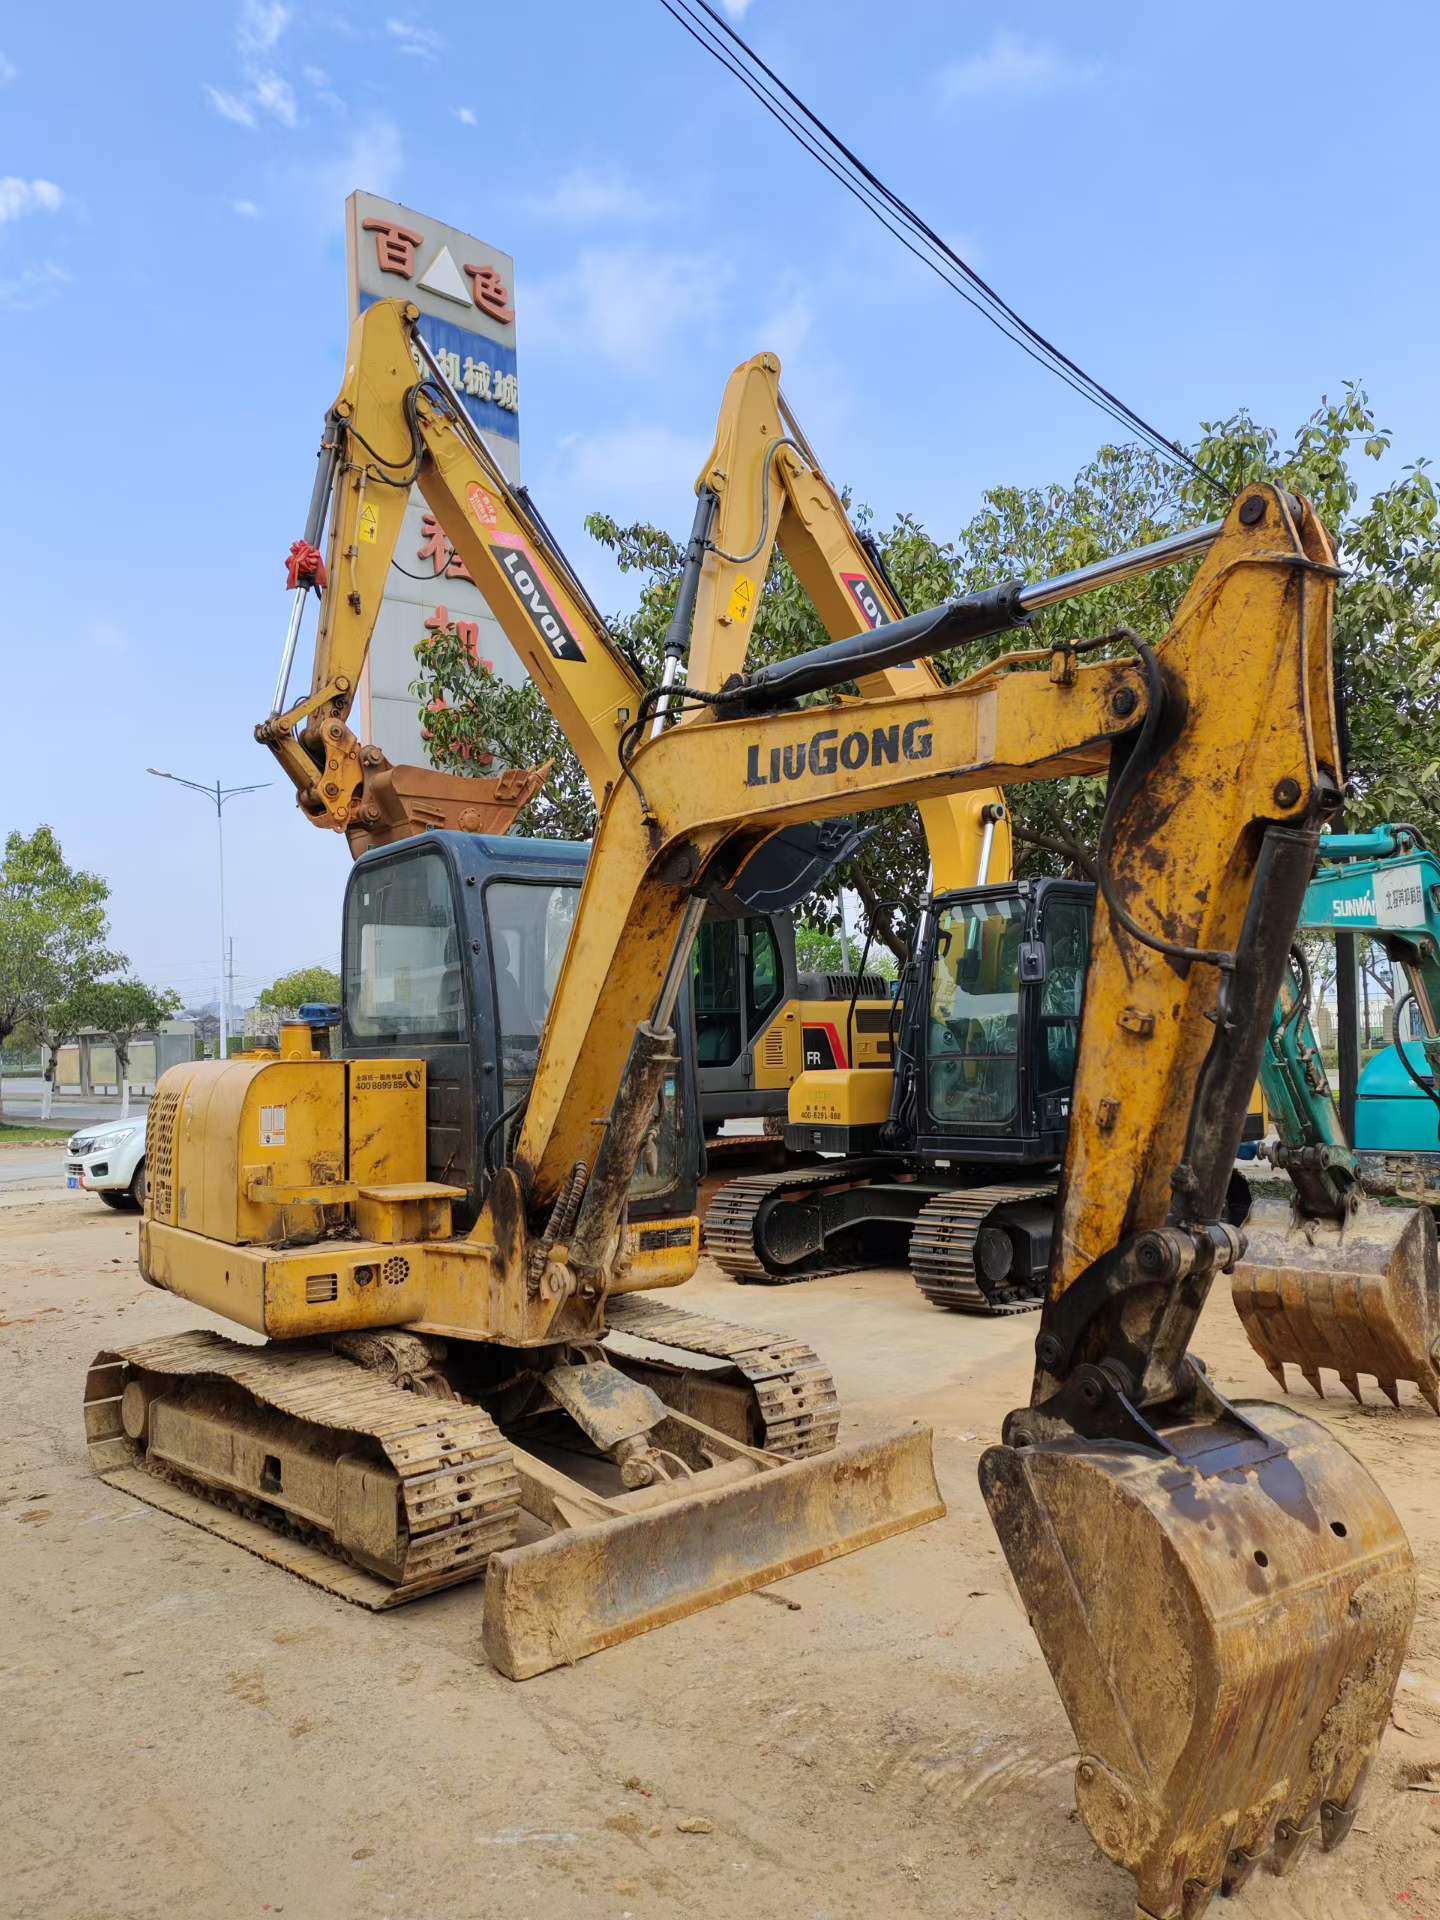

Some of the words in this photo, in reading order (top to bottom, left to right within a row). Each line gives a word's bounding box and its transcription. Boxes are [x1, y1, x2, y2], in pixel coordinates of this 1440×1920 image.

[362, 217, 515, 325] 百色
[503, 552, 567, 657] LOVOL
[747, 718, 933, 787] LIUGONG
[355, 1081, 371, 1090] 400
[806, 1051, 821, 1065] FR
